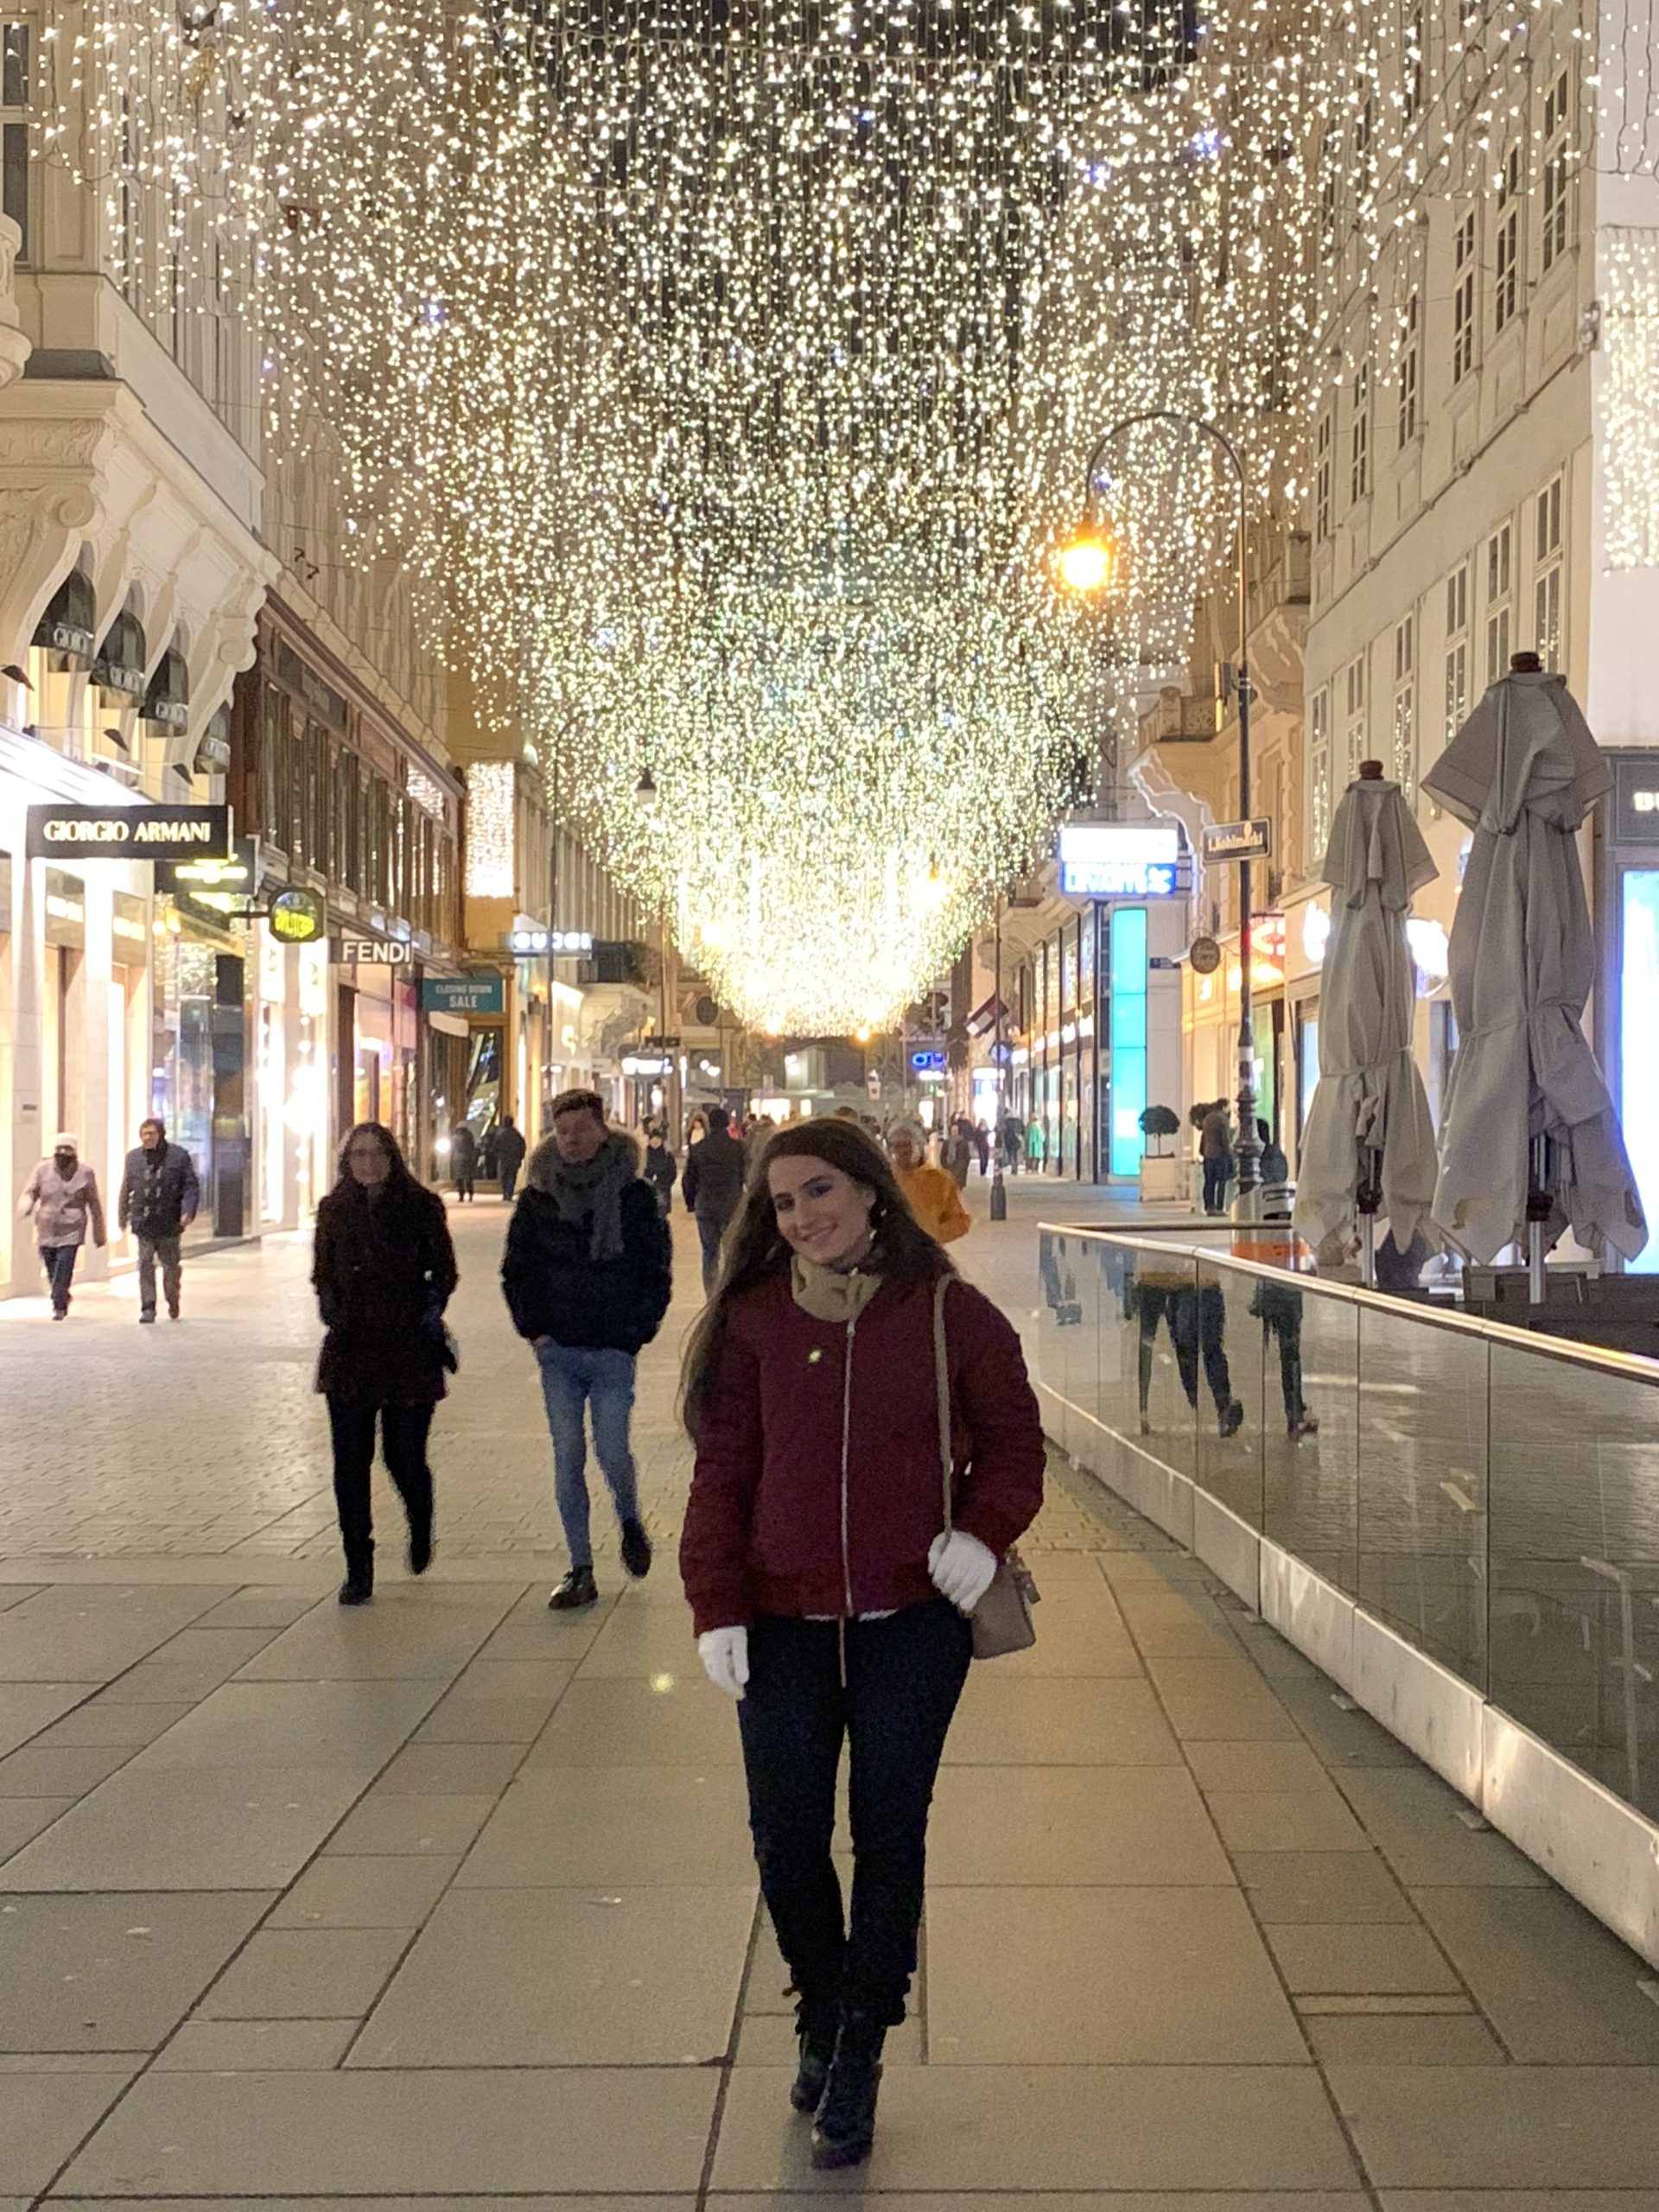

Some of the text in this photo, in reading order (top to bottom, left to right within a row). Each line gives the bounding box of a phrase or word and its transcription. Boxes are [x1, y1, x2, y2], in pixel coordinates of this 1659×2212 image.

[43, 820, 211, 842] GIORGIO ARMANI
[342, 941, 410, 963] FENDI
[449, 995, 478, 1008] SALE
